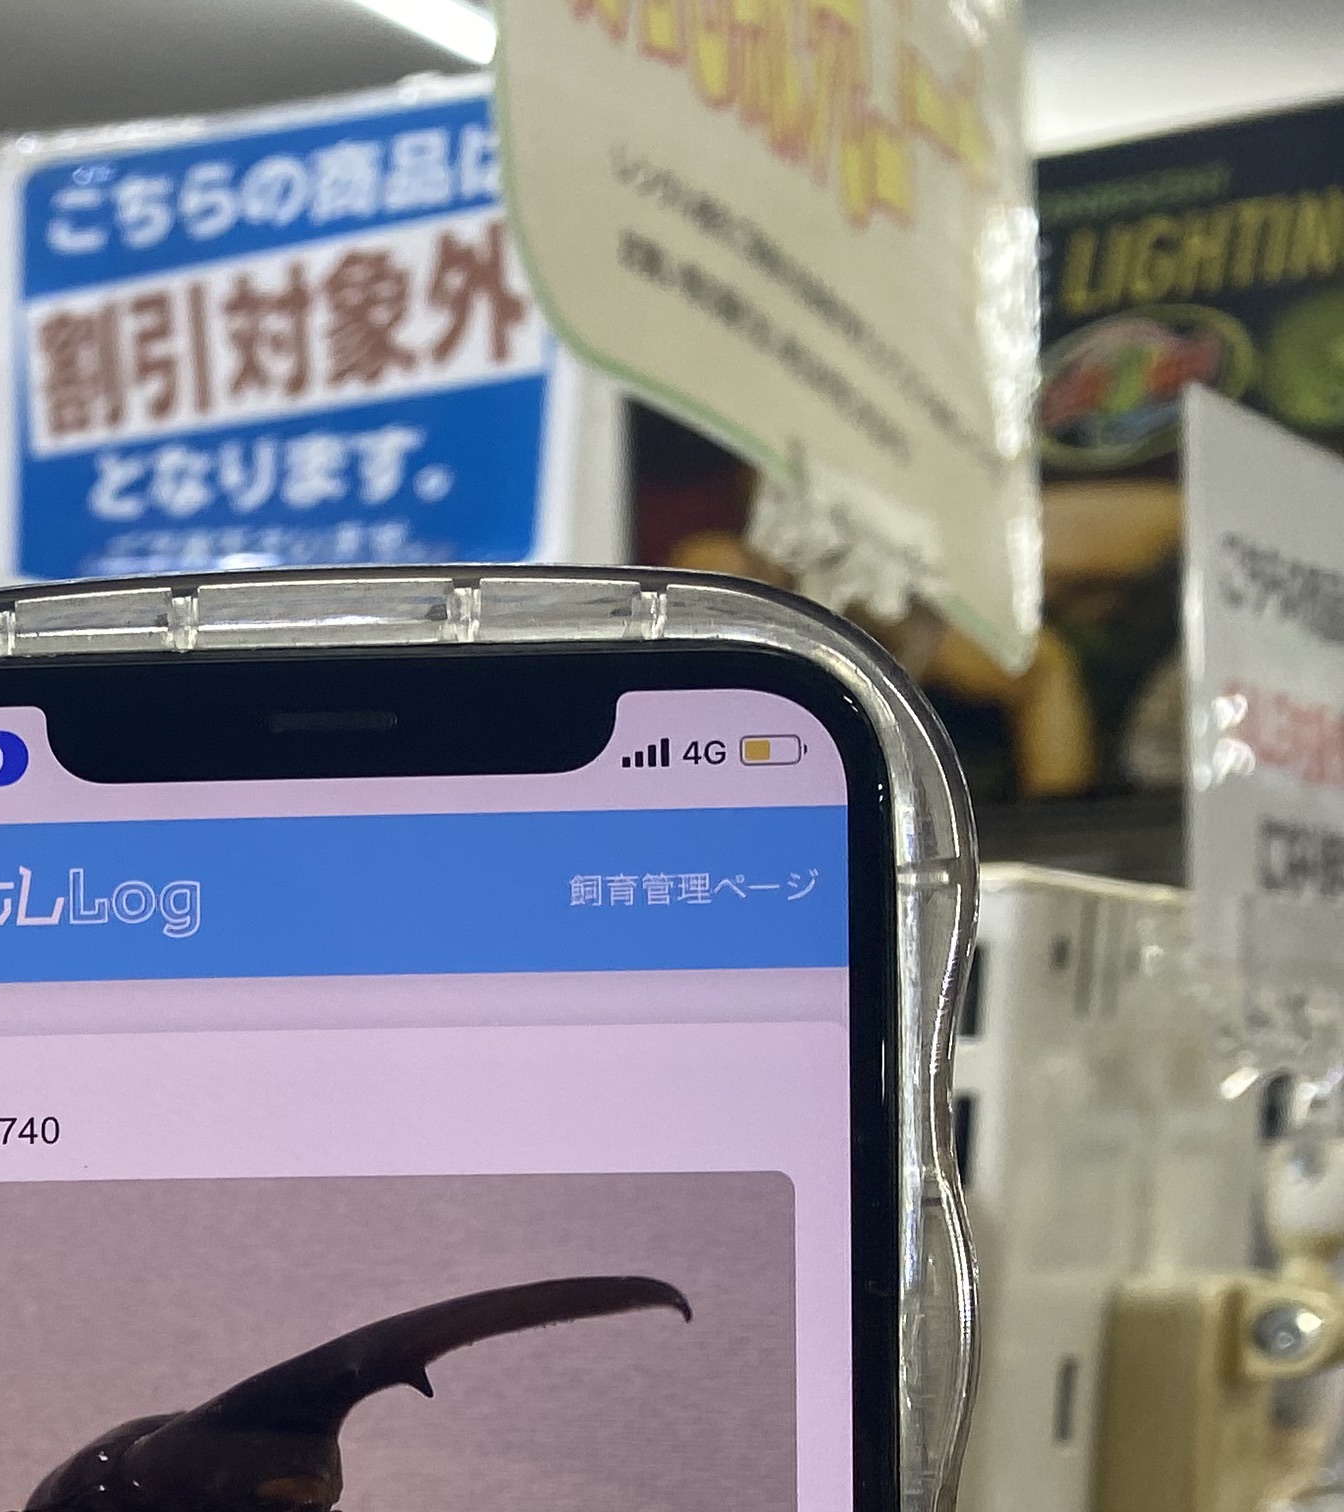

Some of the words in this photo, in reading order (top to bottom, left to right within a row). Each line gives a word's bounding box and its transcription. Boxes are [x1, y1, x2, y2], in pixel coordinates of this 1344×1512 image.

[39, 222, 528, 434] 割引対象外
[89, 428, 454, 521] となります。
[683, 740, 726, 765] 4G
[569, 868, 818, 906] 飼育管理ページ
